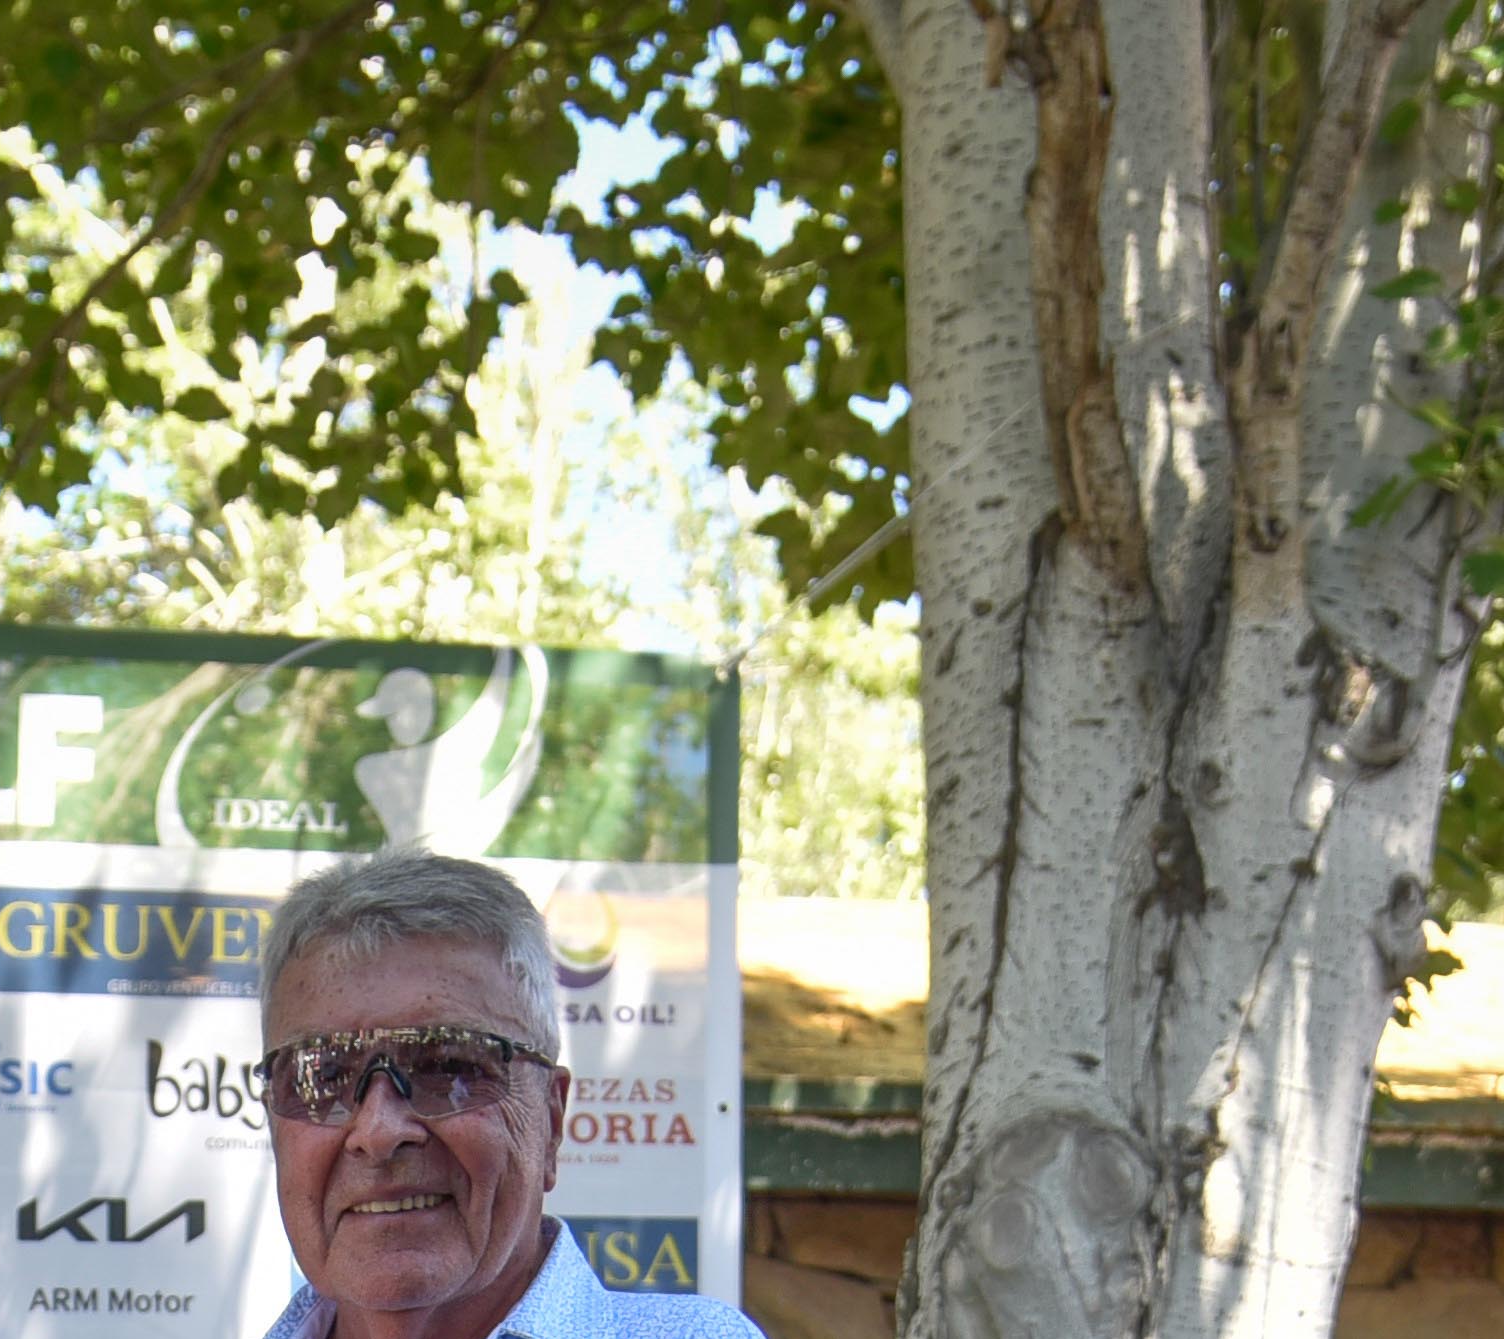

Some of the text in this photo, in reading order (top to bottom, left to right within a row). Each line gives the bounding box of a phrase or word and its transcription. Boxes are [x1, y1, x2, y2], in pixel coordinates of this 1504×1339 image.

[213, 797, 349, 834] IDEAL
[615, 1003, 676, 1025] OIL!
[16, 1198, 206, 1244] KIA
[587, 1230, 696, 1288] SA
[28, 1287, 195, 1315] ARM Motor
